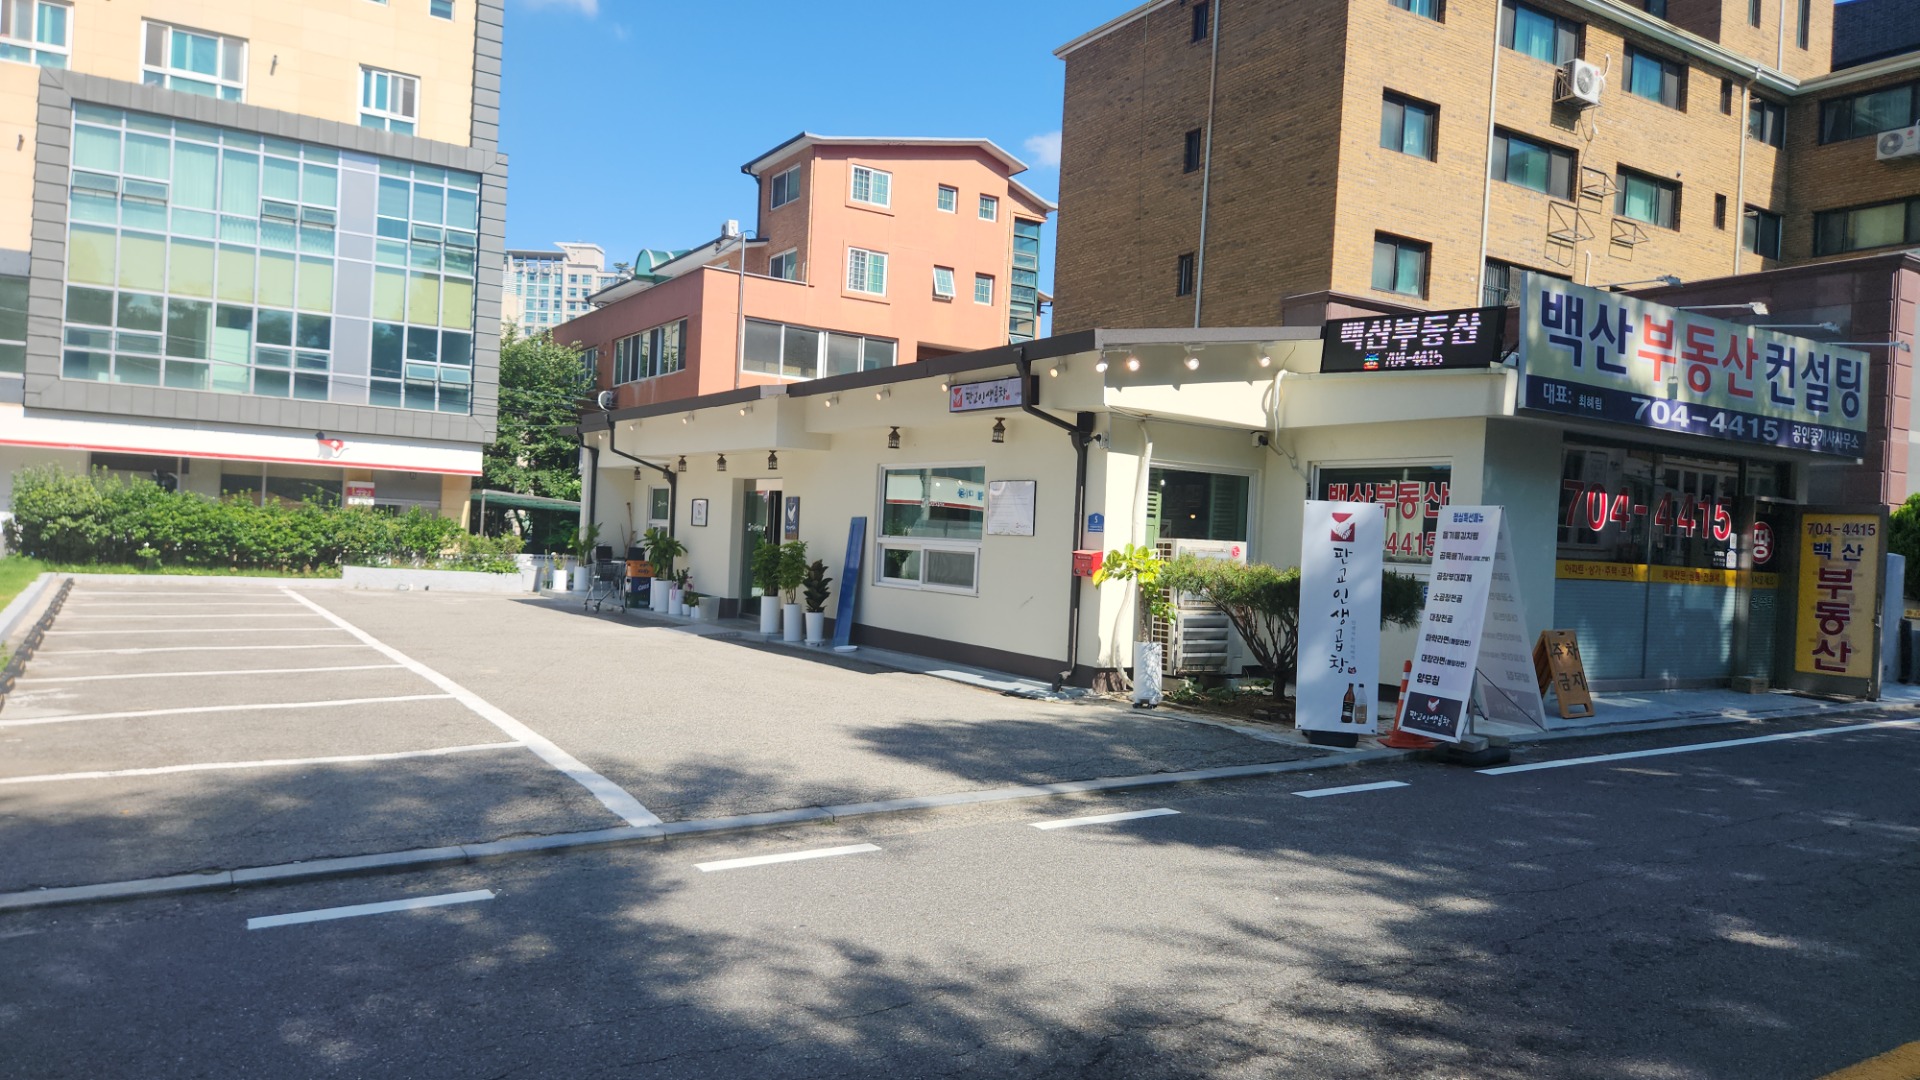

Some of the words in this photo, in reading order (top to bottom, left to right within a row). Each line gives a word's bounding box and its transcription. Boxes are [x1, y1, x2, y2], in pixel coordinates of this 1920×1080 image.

[1340, 312, 1482, 350] 백산부동산
[1541, 290, 1861, 419] 백산부동산컨설팅
[1543, 383, 1572, 404] 대표:
[1631, 396, 1779, 441] 704-4415
[1792, 424, 1859, 450] 공인중개사사무소
[1563, 479, 1732, 541] 704-4415
[1807, 523, 1876, 536] 704-4415
[1329, 548, 1353, 674] 판교인생곱창
[1812, 567, 1853, 673] 부동산
